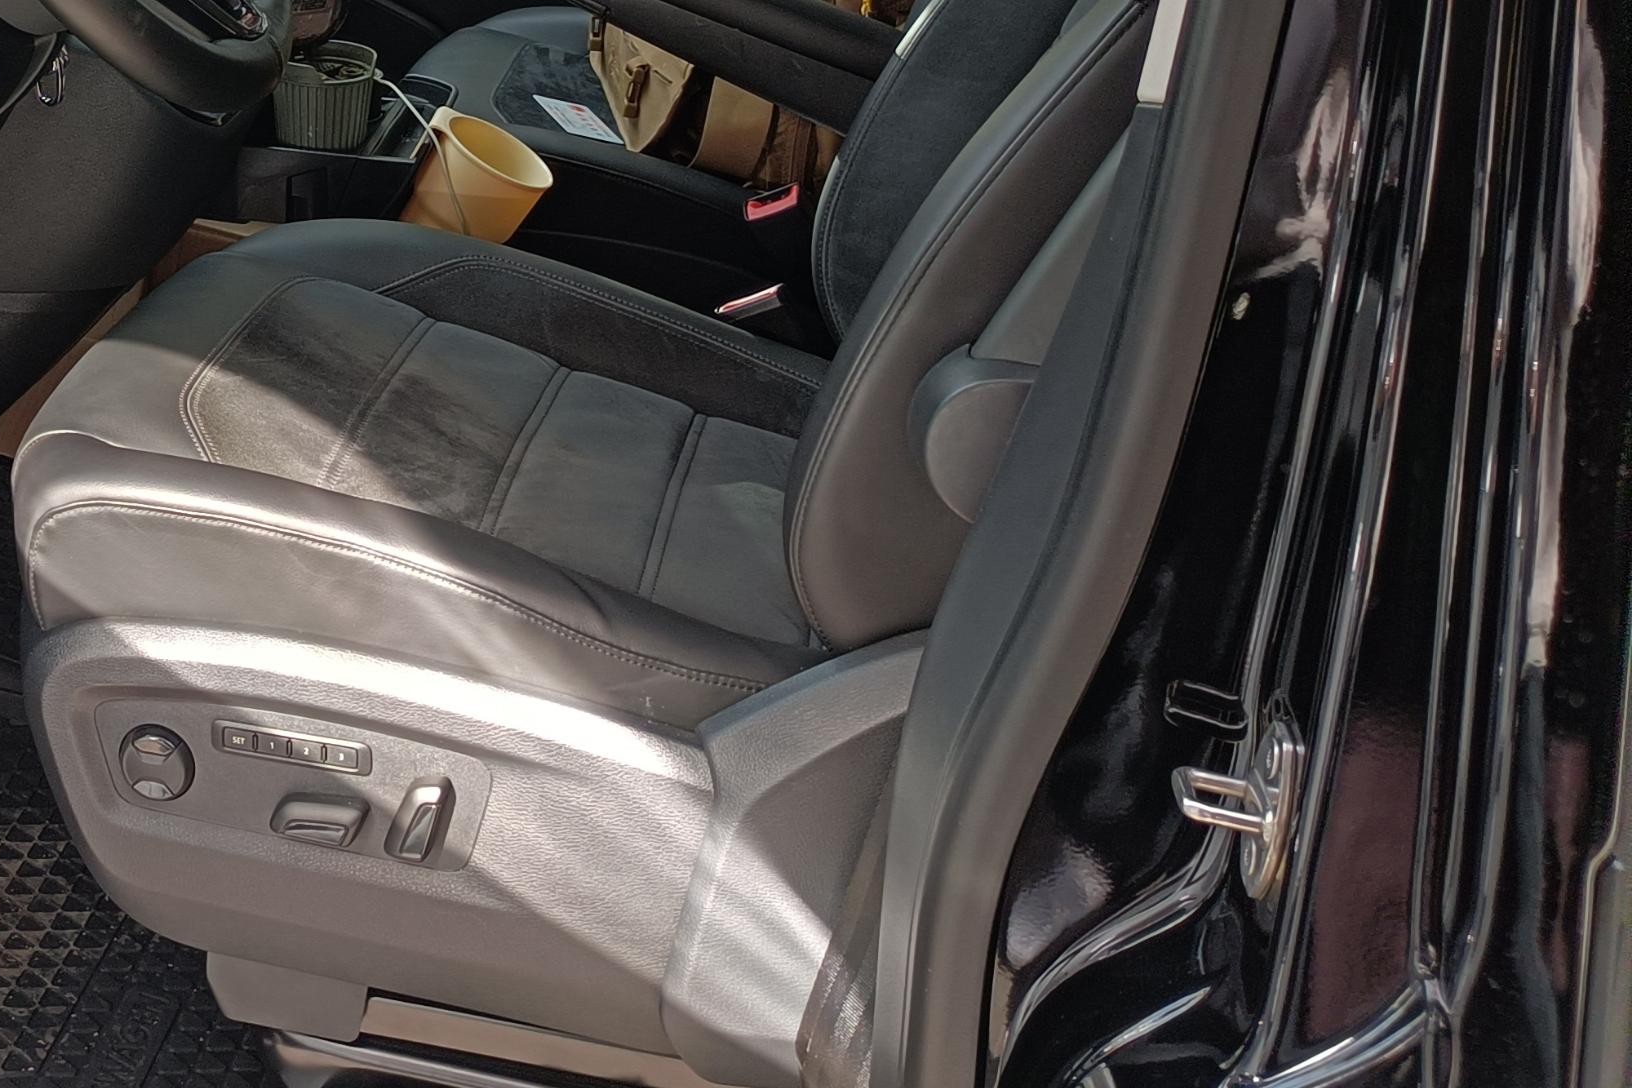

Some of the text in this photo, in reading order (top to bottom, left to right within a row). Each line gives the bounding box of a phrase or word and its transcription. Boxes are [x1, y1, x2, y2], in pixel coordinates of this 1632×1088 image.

[232, 736, 246, 745] SET
[303, 747, 309, 755] 2
[338, 752, 345, 761] 3
